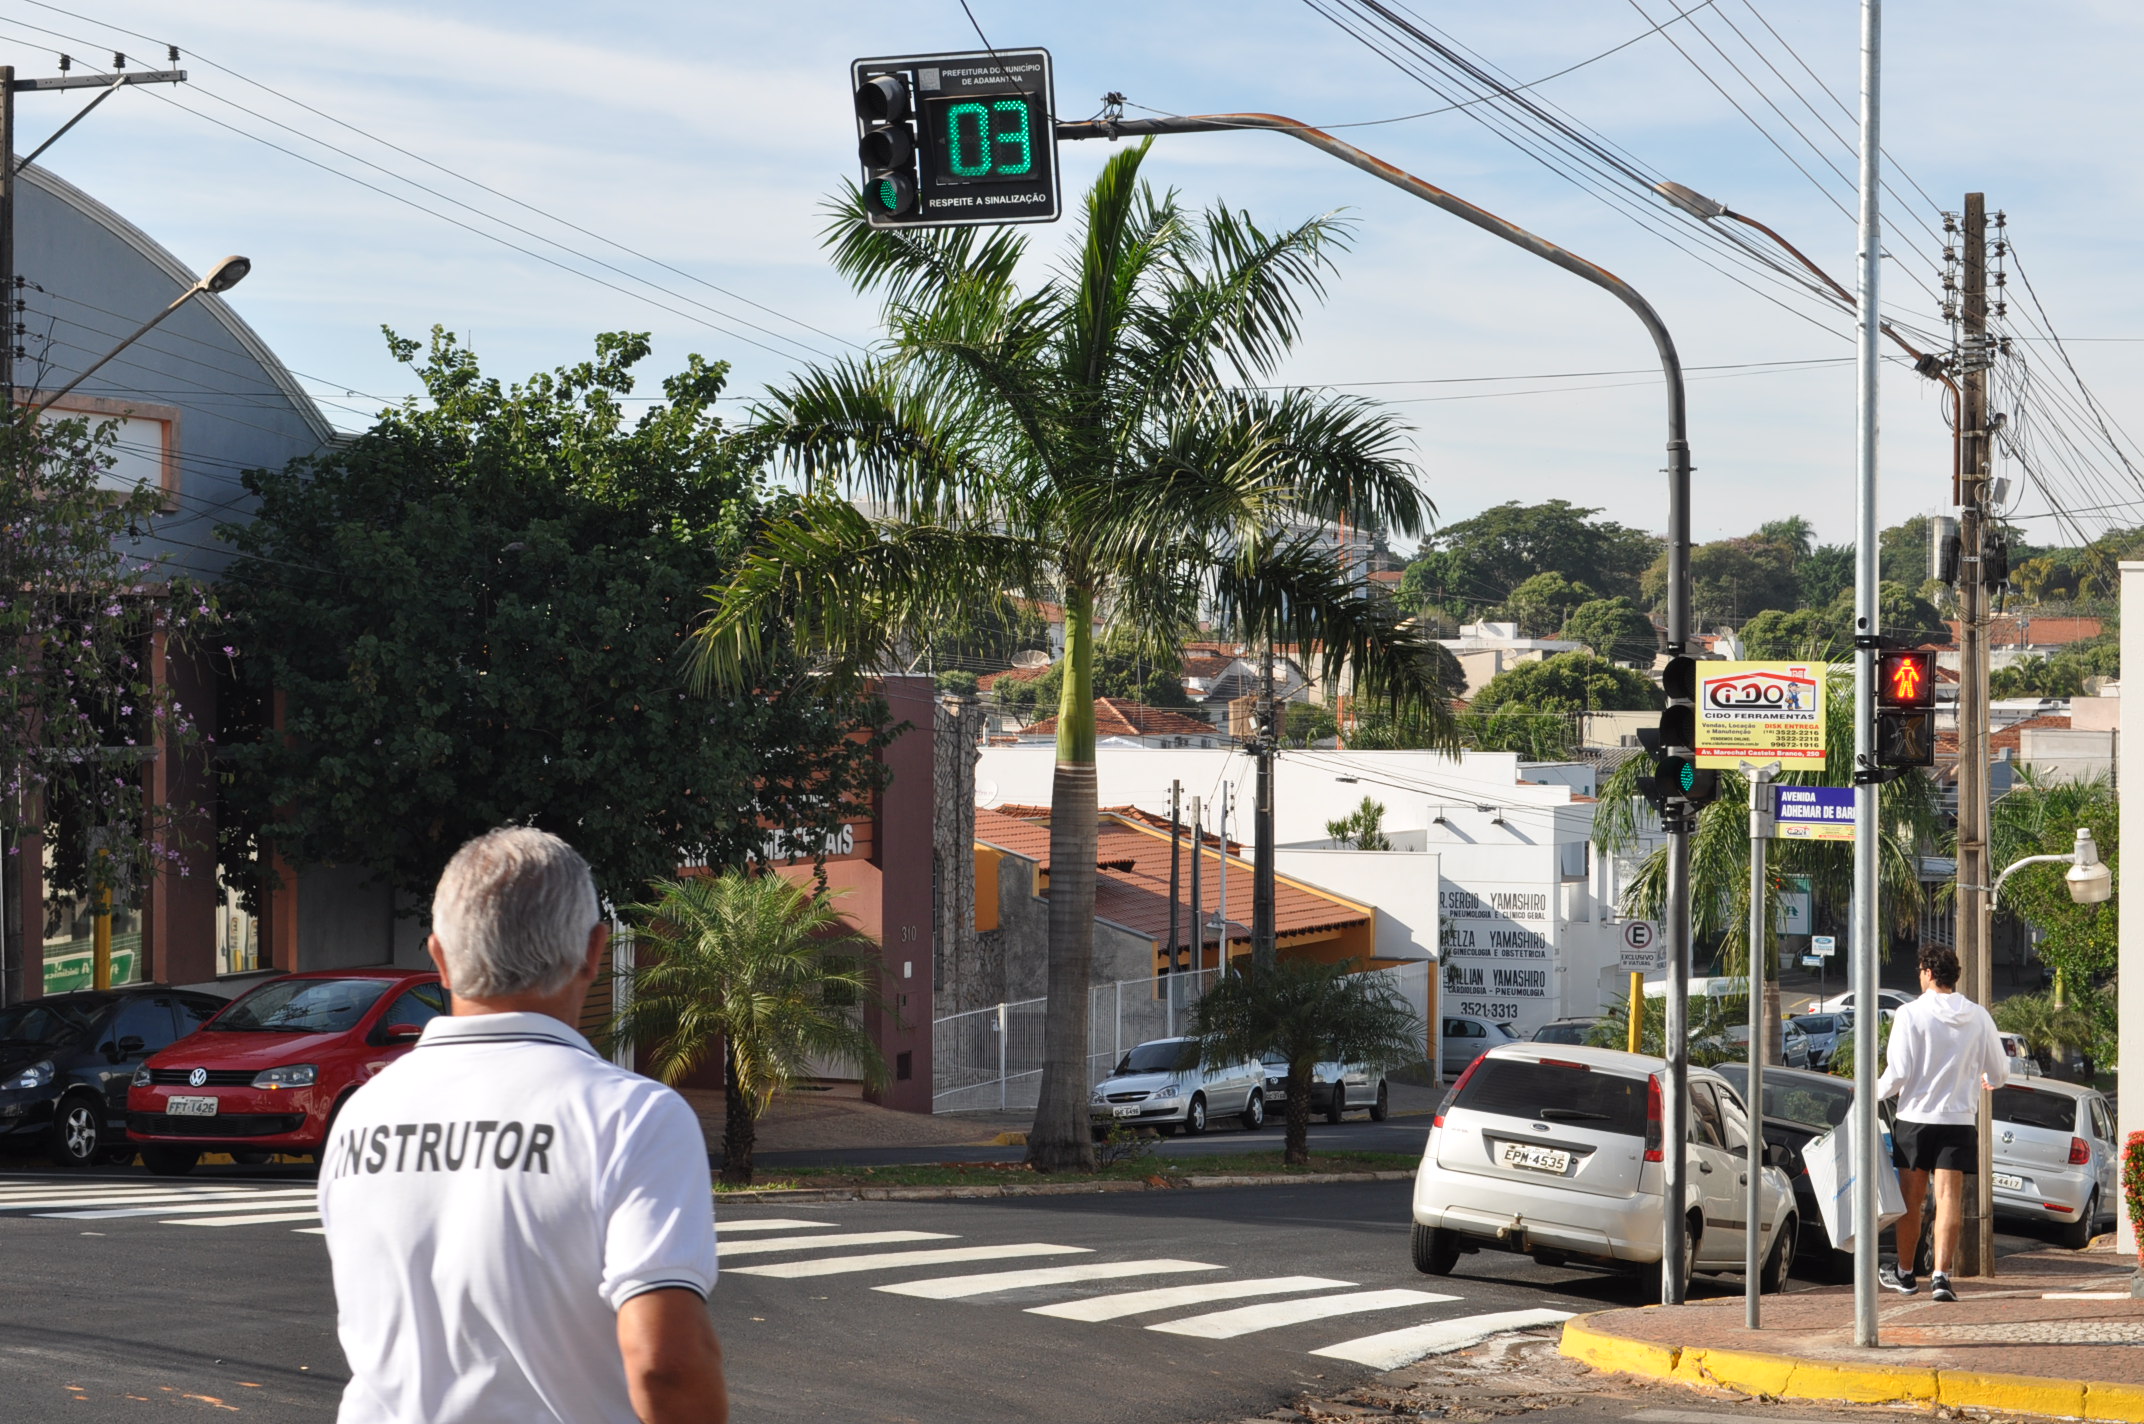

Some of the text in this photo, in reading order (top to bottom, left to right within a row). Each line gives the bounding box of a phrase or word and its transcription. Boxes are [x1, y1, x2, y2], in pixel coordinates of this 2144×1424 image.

[942, 67, 988, 77] PREFEITURA
[1003, 63, 1040, 73] MUNICÍPIO
[974, 75, 1022, 84] ADAMANTNA
[948, 100, 1031, 176] 03
[930, 193, 1046, 207] RESPEITE A SINALIZAÇÃO
[1781, 791, 1816, 802] AVENIDA
[1781, 805, 1821, 818] ADHEMAR
[1823, 806, 1834, 819] DE
[1490, 893, 1546, 911] YAMASHIRO
[1450, 910, 1491, 919] PNEUMOLOGIA
[1527, 912, 1546, 920] GERAL
[902, 925, 916, 942] 310
[1490, 931, 1546, 949] YAMASHIRO
[1632, 927, 1645, 944] E
[1453, 948, 1491, 957] GINECOLOGIA
[1494, 949, 1498, 957] E
[1502, 949, 1546, 958] OBSTETRICIA
[1493, 969, 1546, 988] YAMASHIRO
[1448, 986, 1487, 994] CARDIOLOGIA
[1495, 988, 1545, 997] PNEUMOLOGIA
[1460, 1002, 1518, 1018] 3521-3313
